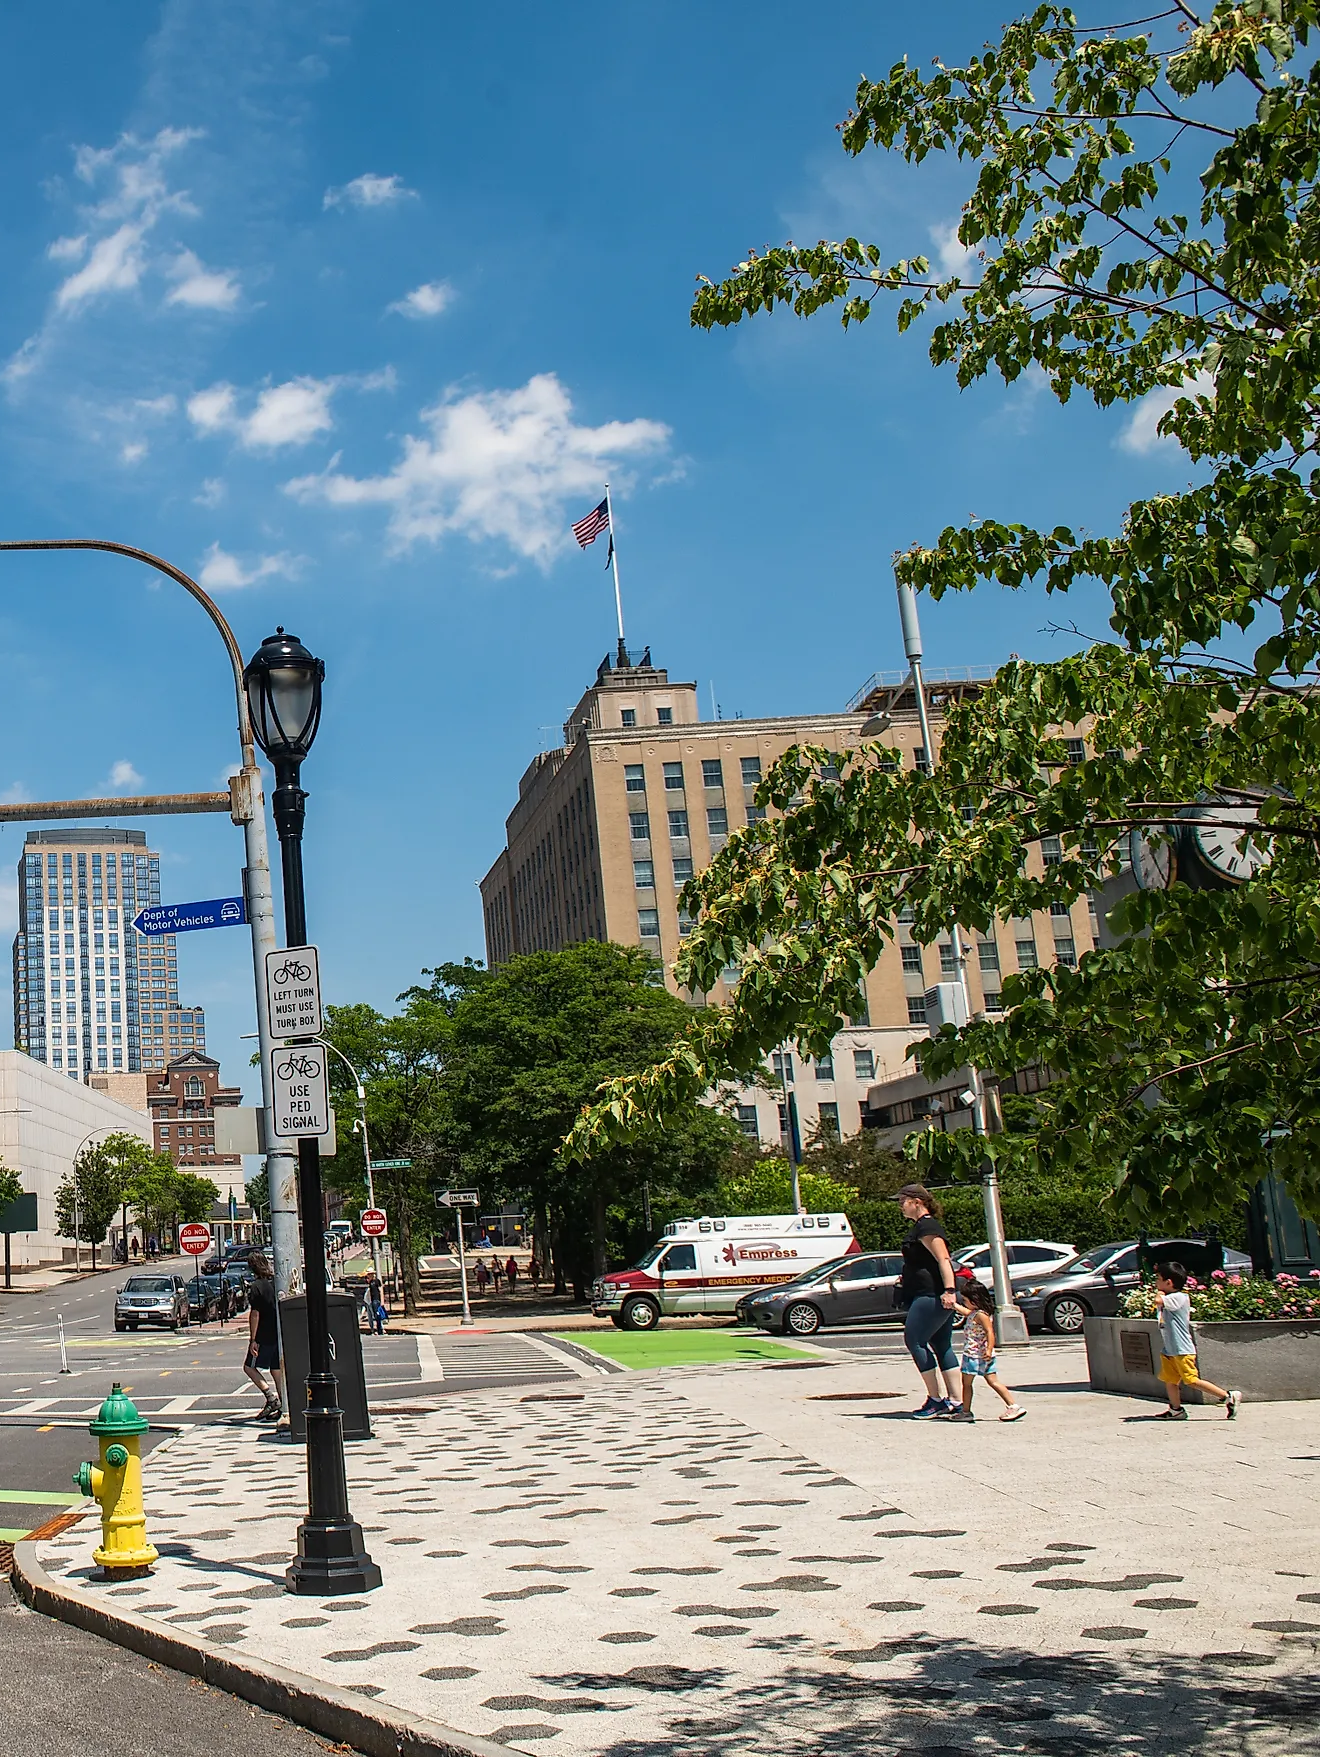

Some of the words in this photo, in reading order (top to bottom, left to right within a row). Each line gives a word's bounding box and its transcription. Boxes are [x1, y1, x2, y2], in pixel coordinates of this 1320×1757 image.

[143, 910, 165, 921] Dept
[168, 907, 178, 917] of
[144, 920, 171, 931] Motor
[174, 915, 214, 927] Vehicles
[273, 990, 291, 1001] LEFT
[293, 987, 314, 998] TURN
[276, 1003, 296, 1014] MUST
[299, 1001, 314, 1011] USE
[277, 1017, 297, 1028] TURN
[299, 1015, 315, 1026] BOX
[289, 1084, 310, 1097] USE
[290, 1100, 311, 1113] PED
[282, 1115, 320, 1129] SIGNAL
[740, 1249, 798, 1260] Empress
[708, 1277, 762, 1286] EMERGENCY
